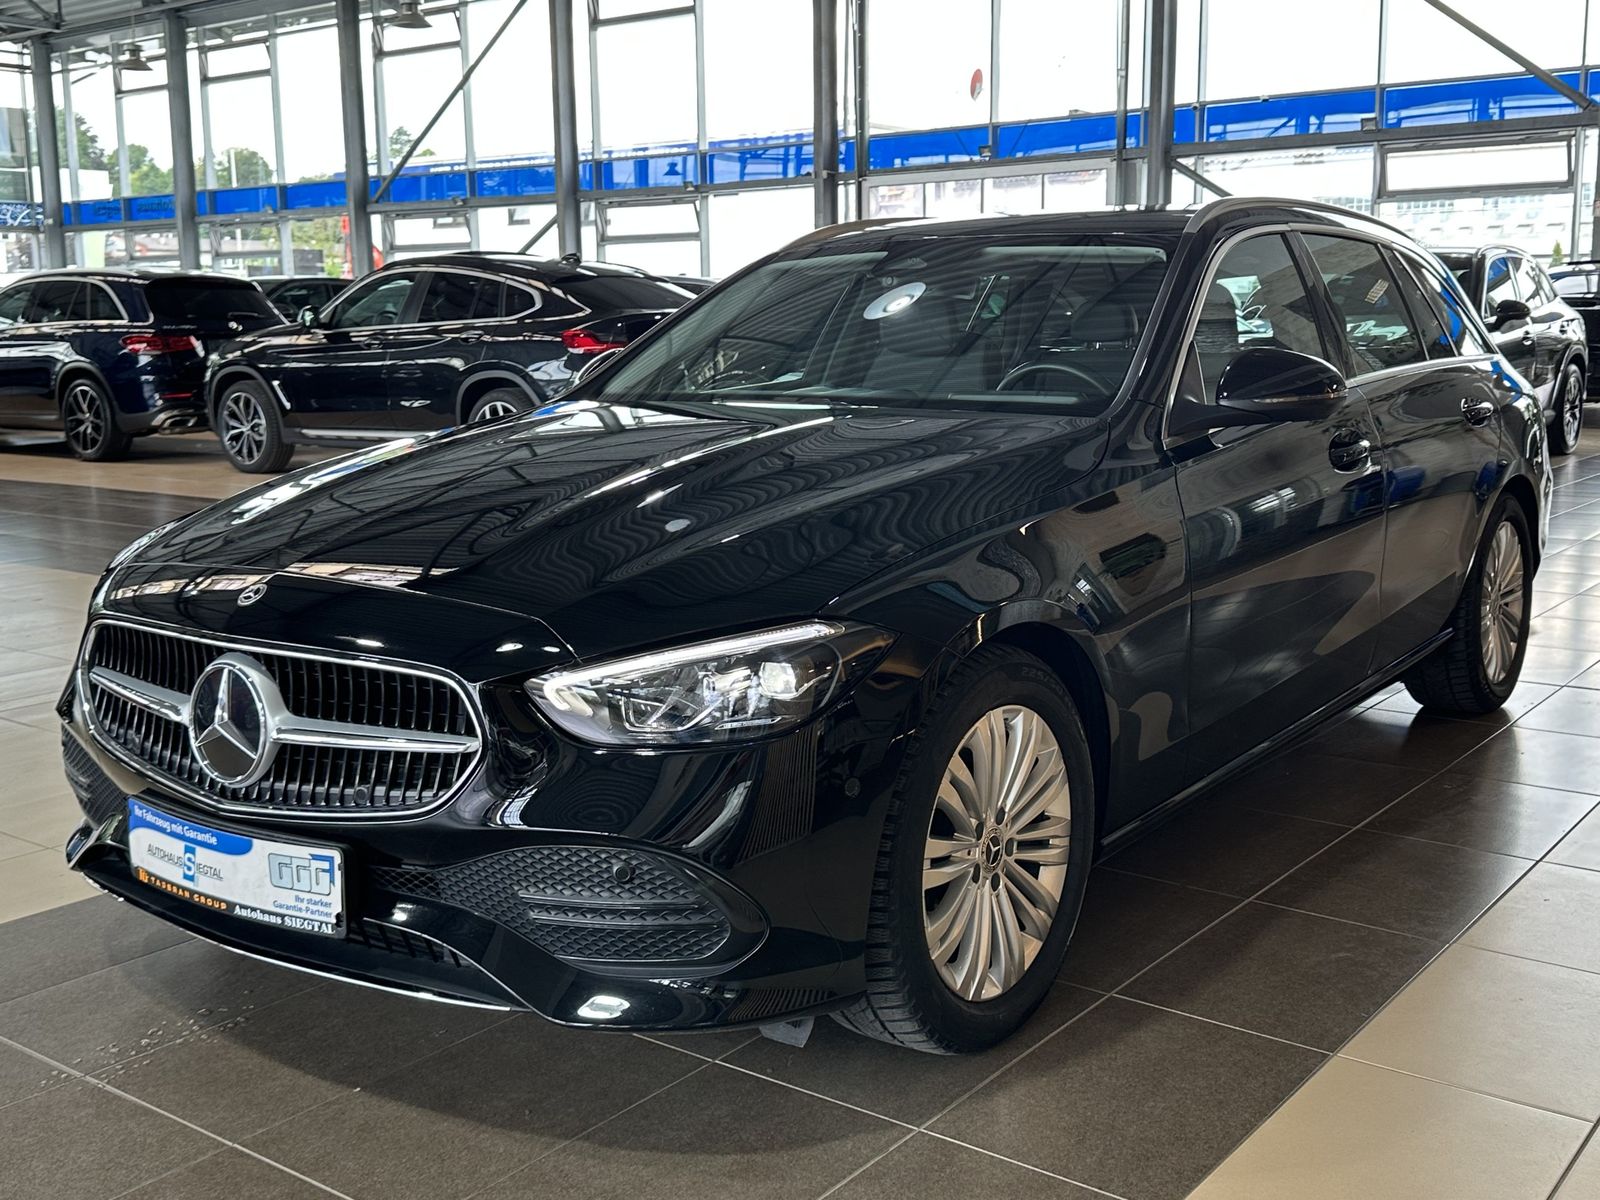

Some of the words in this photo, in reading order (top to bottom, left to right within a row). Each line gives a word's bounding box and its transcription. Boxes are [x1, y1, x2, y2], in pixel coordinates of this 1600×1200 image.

[143, 808, 171, 832] Fahrzeug
[171, 822, 184, 835] mit
[183, 826, 218, 845] Garantie
[147, 843, 183, 867] AUTOHAUS
[184, 852, 224, 879] SIEGTAL
[193, 894, 227, 910] GROUP
[273, 900, 332, 918] Garantie-Partner
[294, 895, 305, 903] Ihr
[306, 897, 332, 909] starker
[233, 905, 282, 924] Autohaus
[284, 915, 336, 934] SIEGTAL
